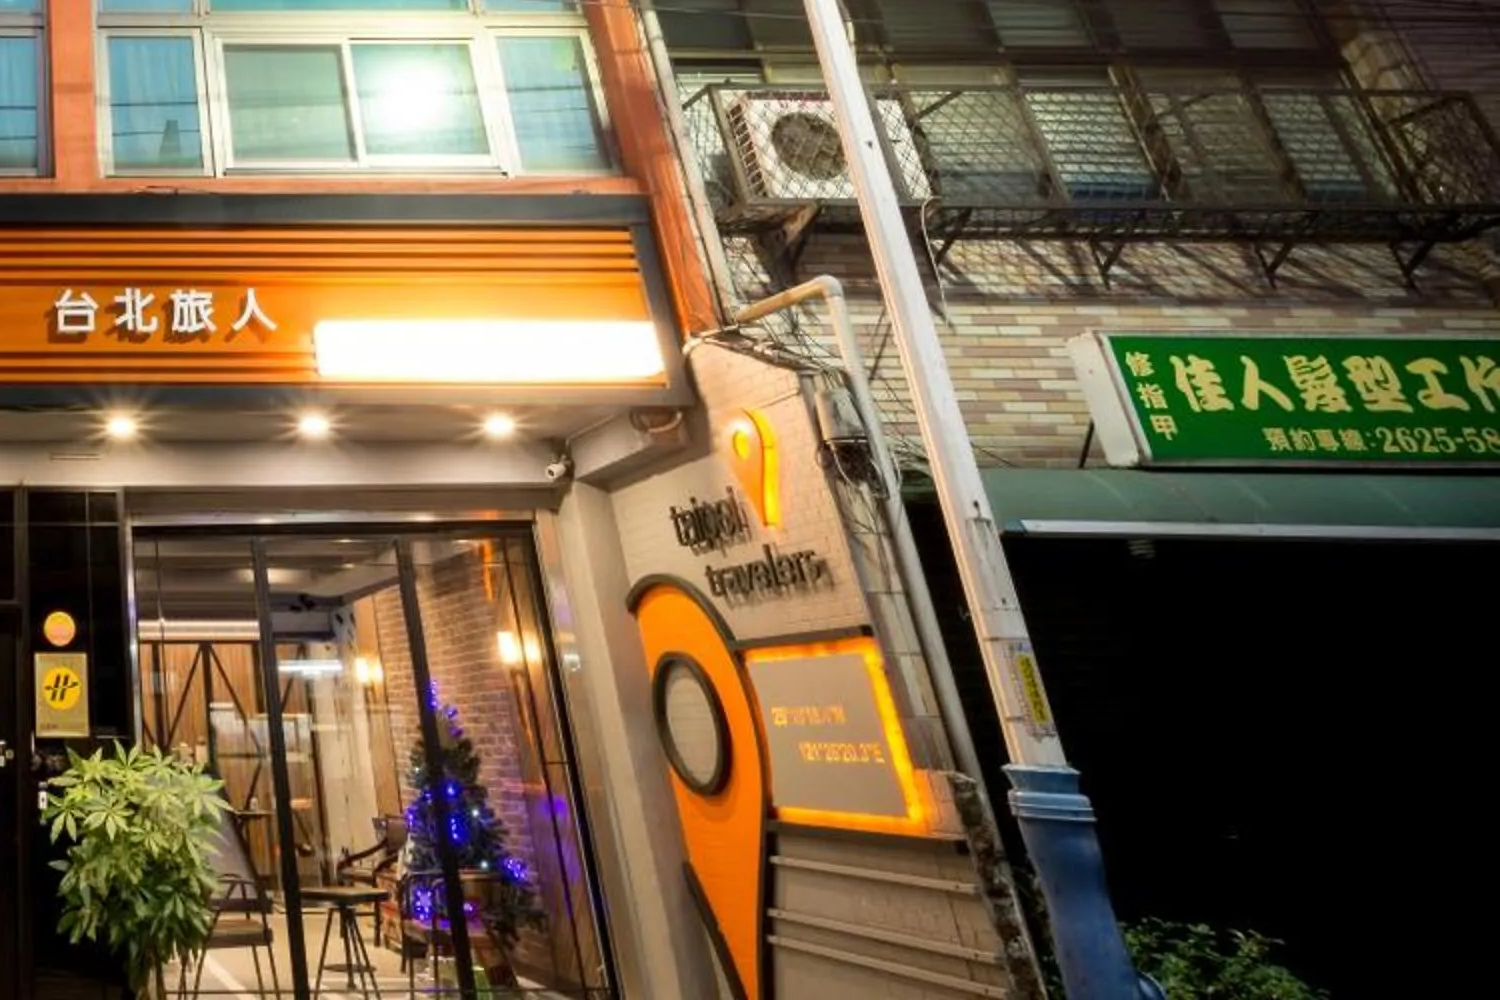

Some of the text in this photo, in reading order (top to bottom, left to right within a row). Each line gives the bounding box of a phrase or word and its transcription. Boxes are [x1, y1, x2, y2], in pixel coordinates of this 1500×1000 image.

[54, 287, 278, 334] 台北旅人
[1125, 351, 1179, 441] 修指甲
